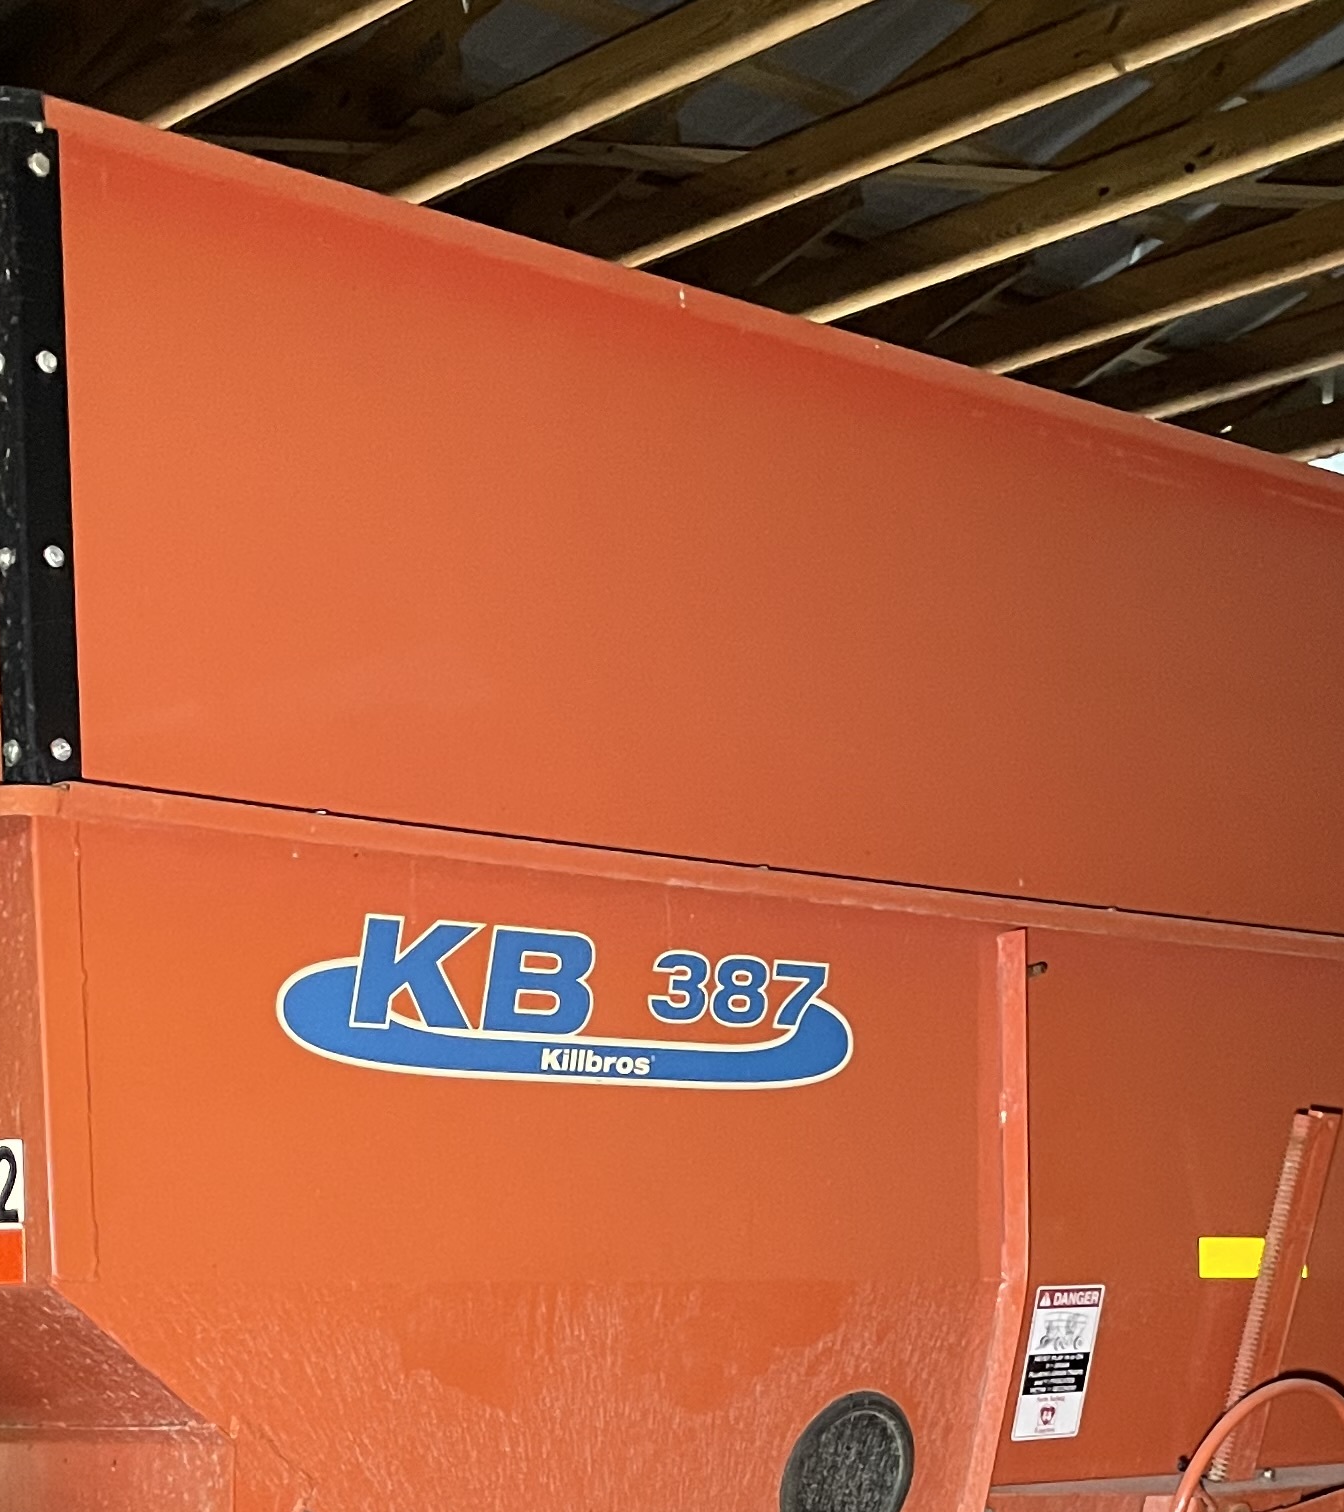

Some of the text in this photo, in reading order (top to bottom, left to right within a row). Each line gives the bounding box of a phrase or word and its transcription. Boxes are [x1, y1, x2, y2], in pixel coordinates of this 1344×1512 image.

[349, 913, 830, 1036] KB 387
[541, 1048, 650, 1075] Killbros
[1053, 1291, 1100, 1306] DANGER
